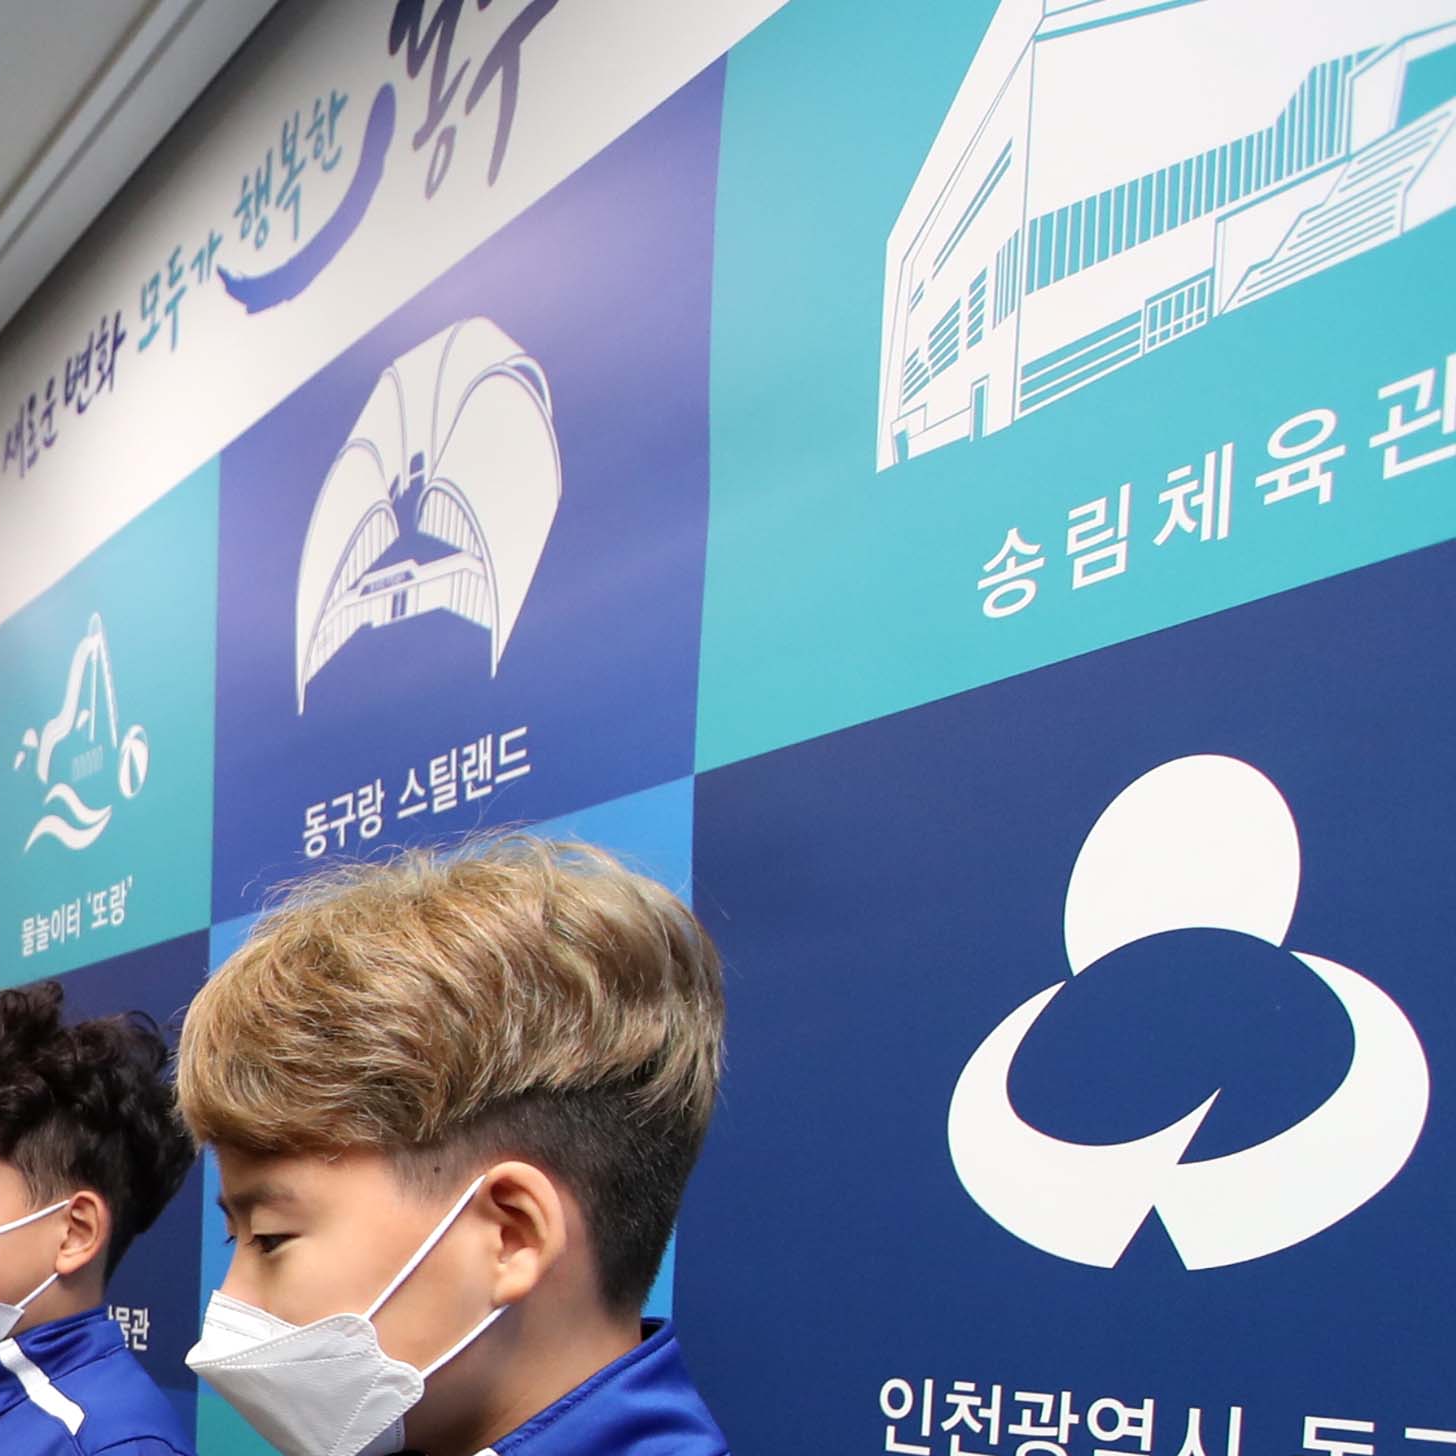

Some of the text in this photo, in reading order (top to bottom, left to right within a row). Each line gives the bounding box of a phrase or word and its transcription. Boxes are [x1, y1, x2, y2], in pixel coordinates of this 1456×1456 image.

[2, 376, 58, 479] 새로운
[64, 311, 127, 415] 변화
[138, 230, 225, 354] 모두가
[234, 89, 349, 251] 행복한
[976, 352, 1456, 620] 송림체육관
[302, 726, 531, 860] 동구랑 스틸랜드
[20, 898, 81, 957] 물놀이터
